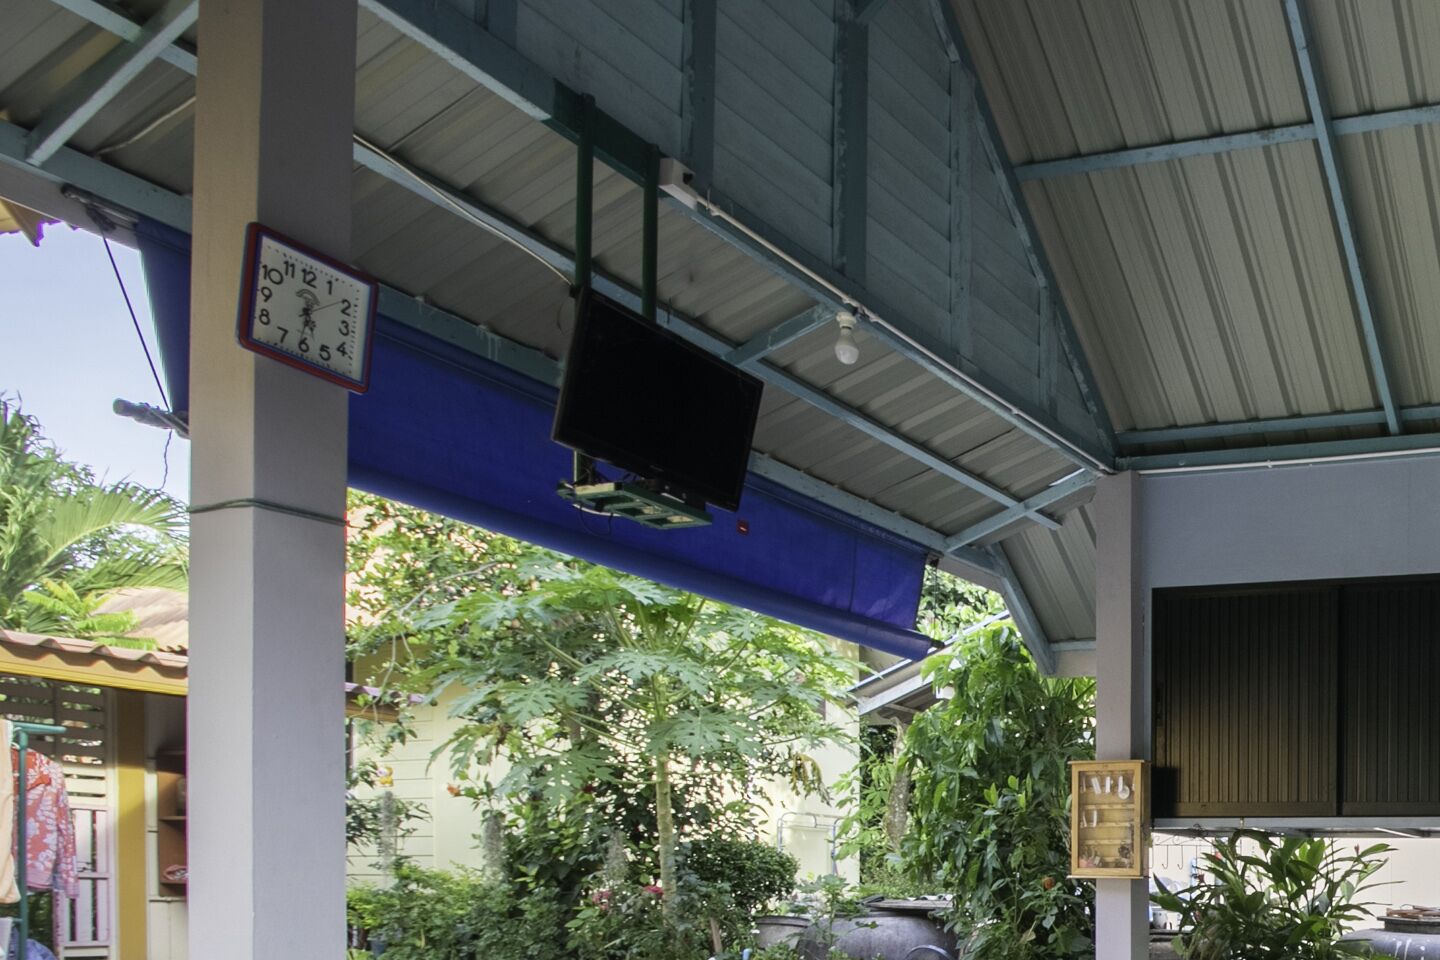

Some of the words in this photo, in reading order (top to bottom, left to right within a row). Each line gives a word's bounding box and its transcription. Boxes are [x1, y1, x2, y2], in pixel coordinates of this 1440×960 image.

[262, 264, 284, 285] 10
[283, 260, 296, 279] 11
[301, 268, 318, 289] 12
[260, 286, 273, 303] 9
[326, 280, 334, 295] 1
[340, 299, 352, 316] 2
[259, 309, 271, 326] 8
[276, 326, 289, 343] 7
[338, 320, 351, 337] 3
[298, 337, 310, 354] 6
[319, 344, 332, 361] 5
[336, 341, 349, 357] 4
